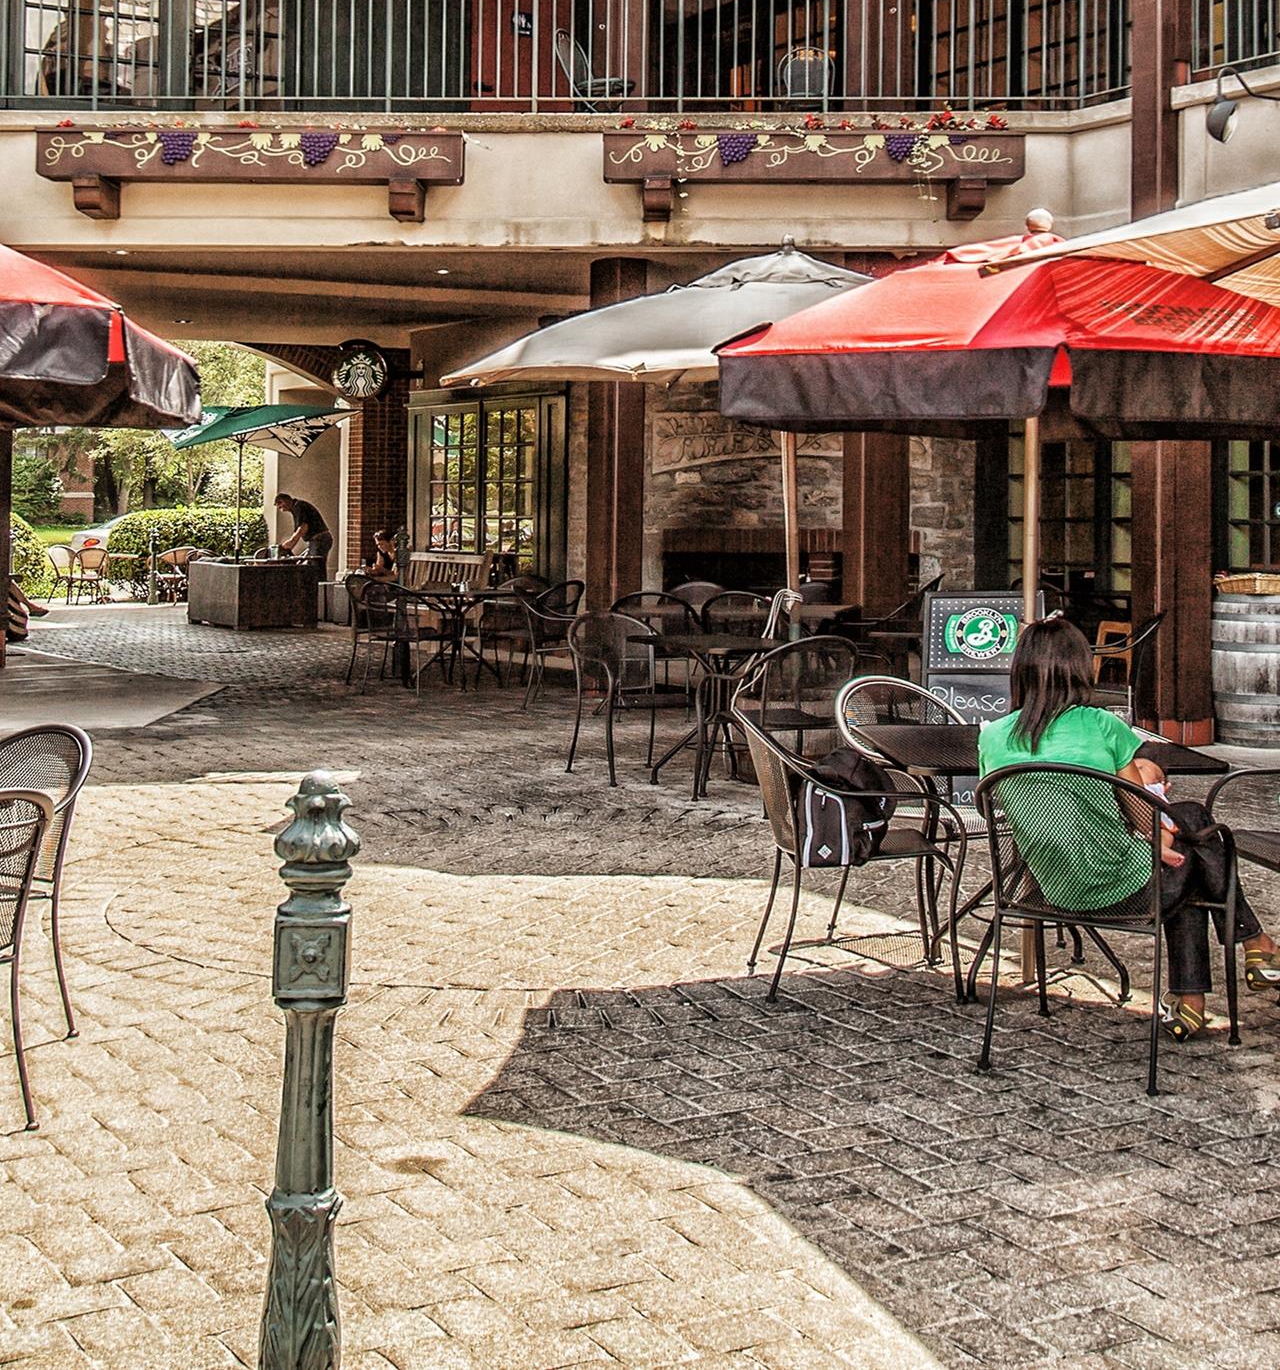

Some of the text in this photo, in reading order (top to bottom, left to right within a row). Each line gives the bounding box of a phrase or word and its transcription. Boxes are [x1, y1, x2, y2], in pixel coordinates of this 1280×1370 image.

[961, 608, 1004, 625] BROOKLYN
[960, 642, 1002, 658] BREWERY
[929, 686, 1007, 713] Please
